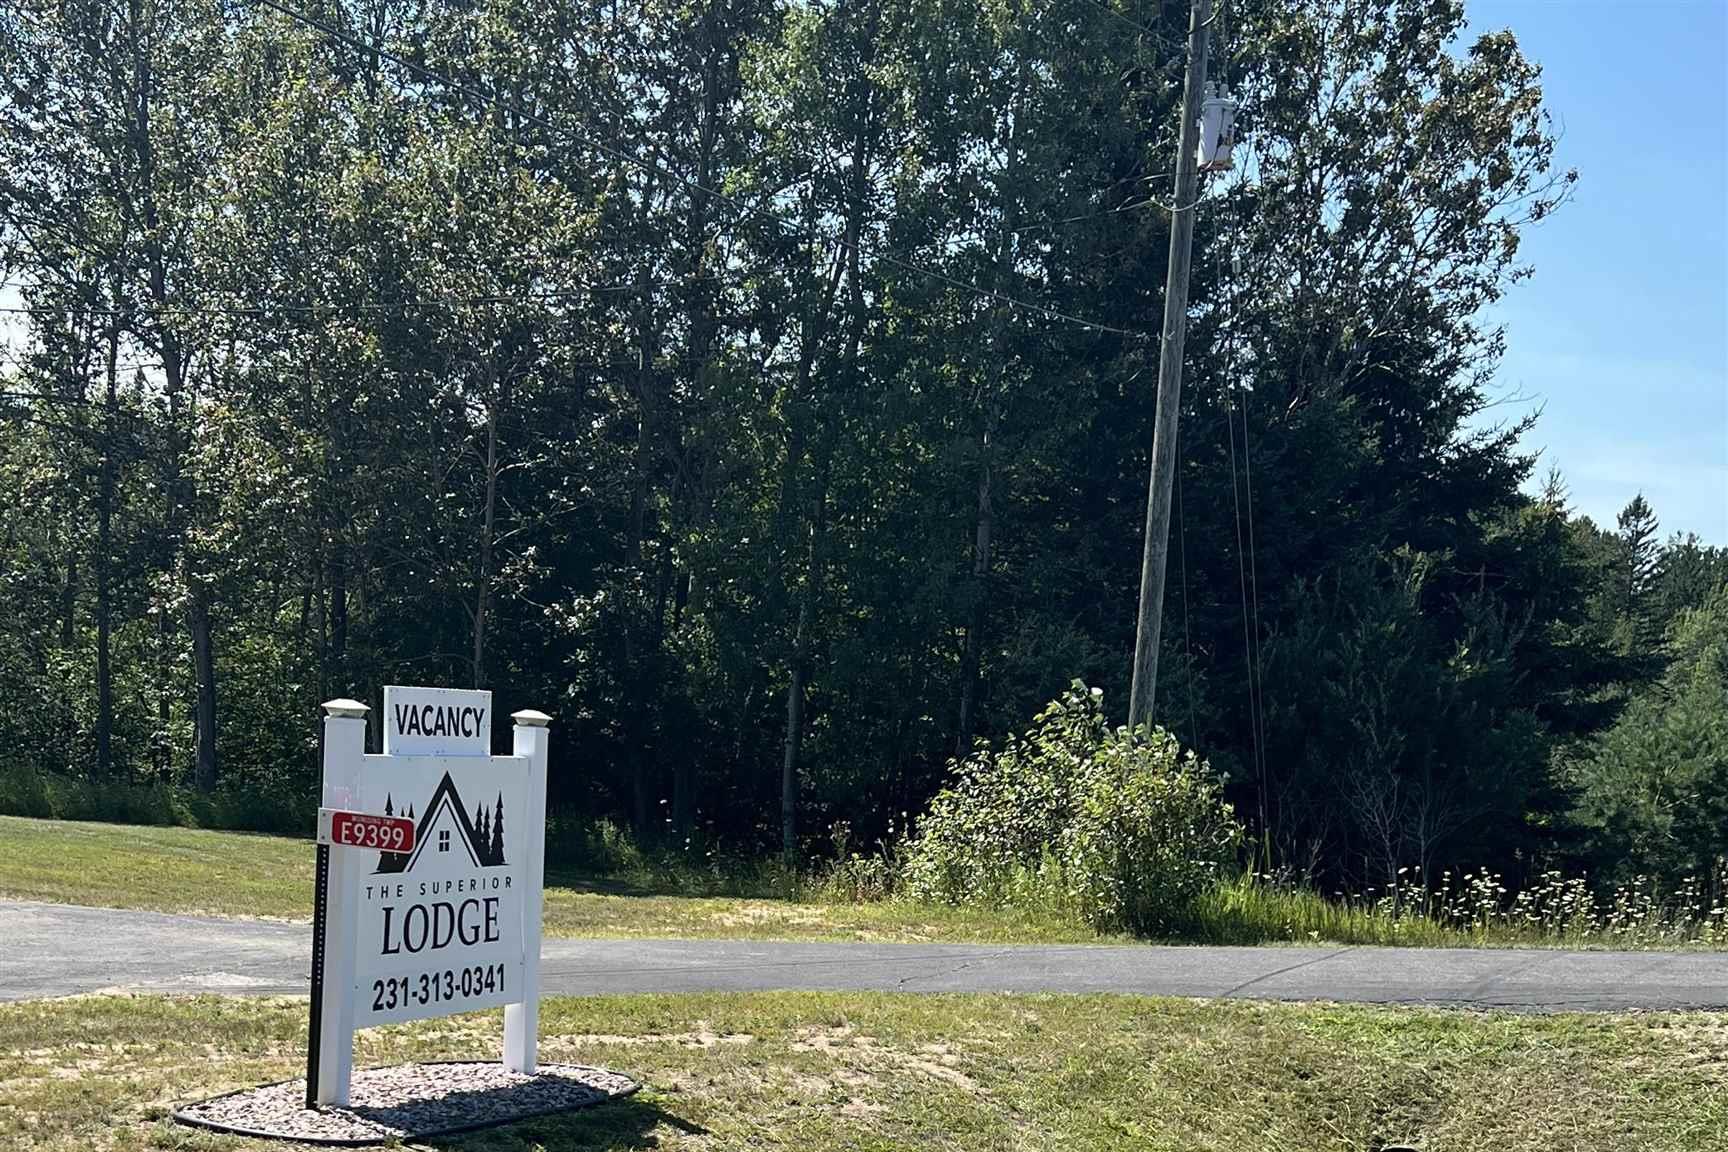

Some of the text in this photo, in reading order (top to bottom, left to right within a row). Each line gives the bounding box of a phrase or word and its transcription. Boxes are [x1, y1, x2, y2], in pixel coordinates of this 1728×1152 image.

[395, 704, 485, 737] VACANCY
[341, 821, 404, 849] E9399
[366, 876, 512, 900] THE SUPERIOR
[381, 897, 500, 955] LODGE
[372, 963, 505, 1012] 231-313-0341
